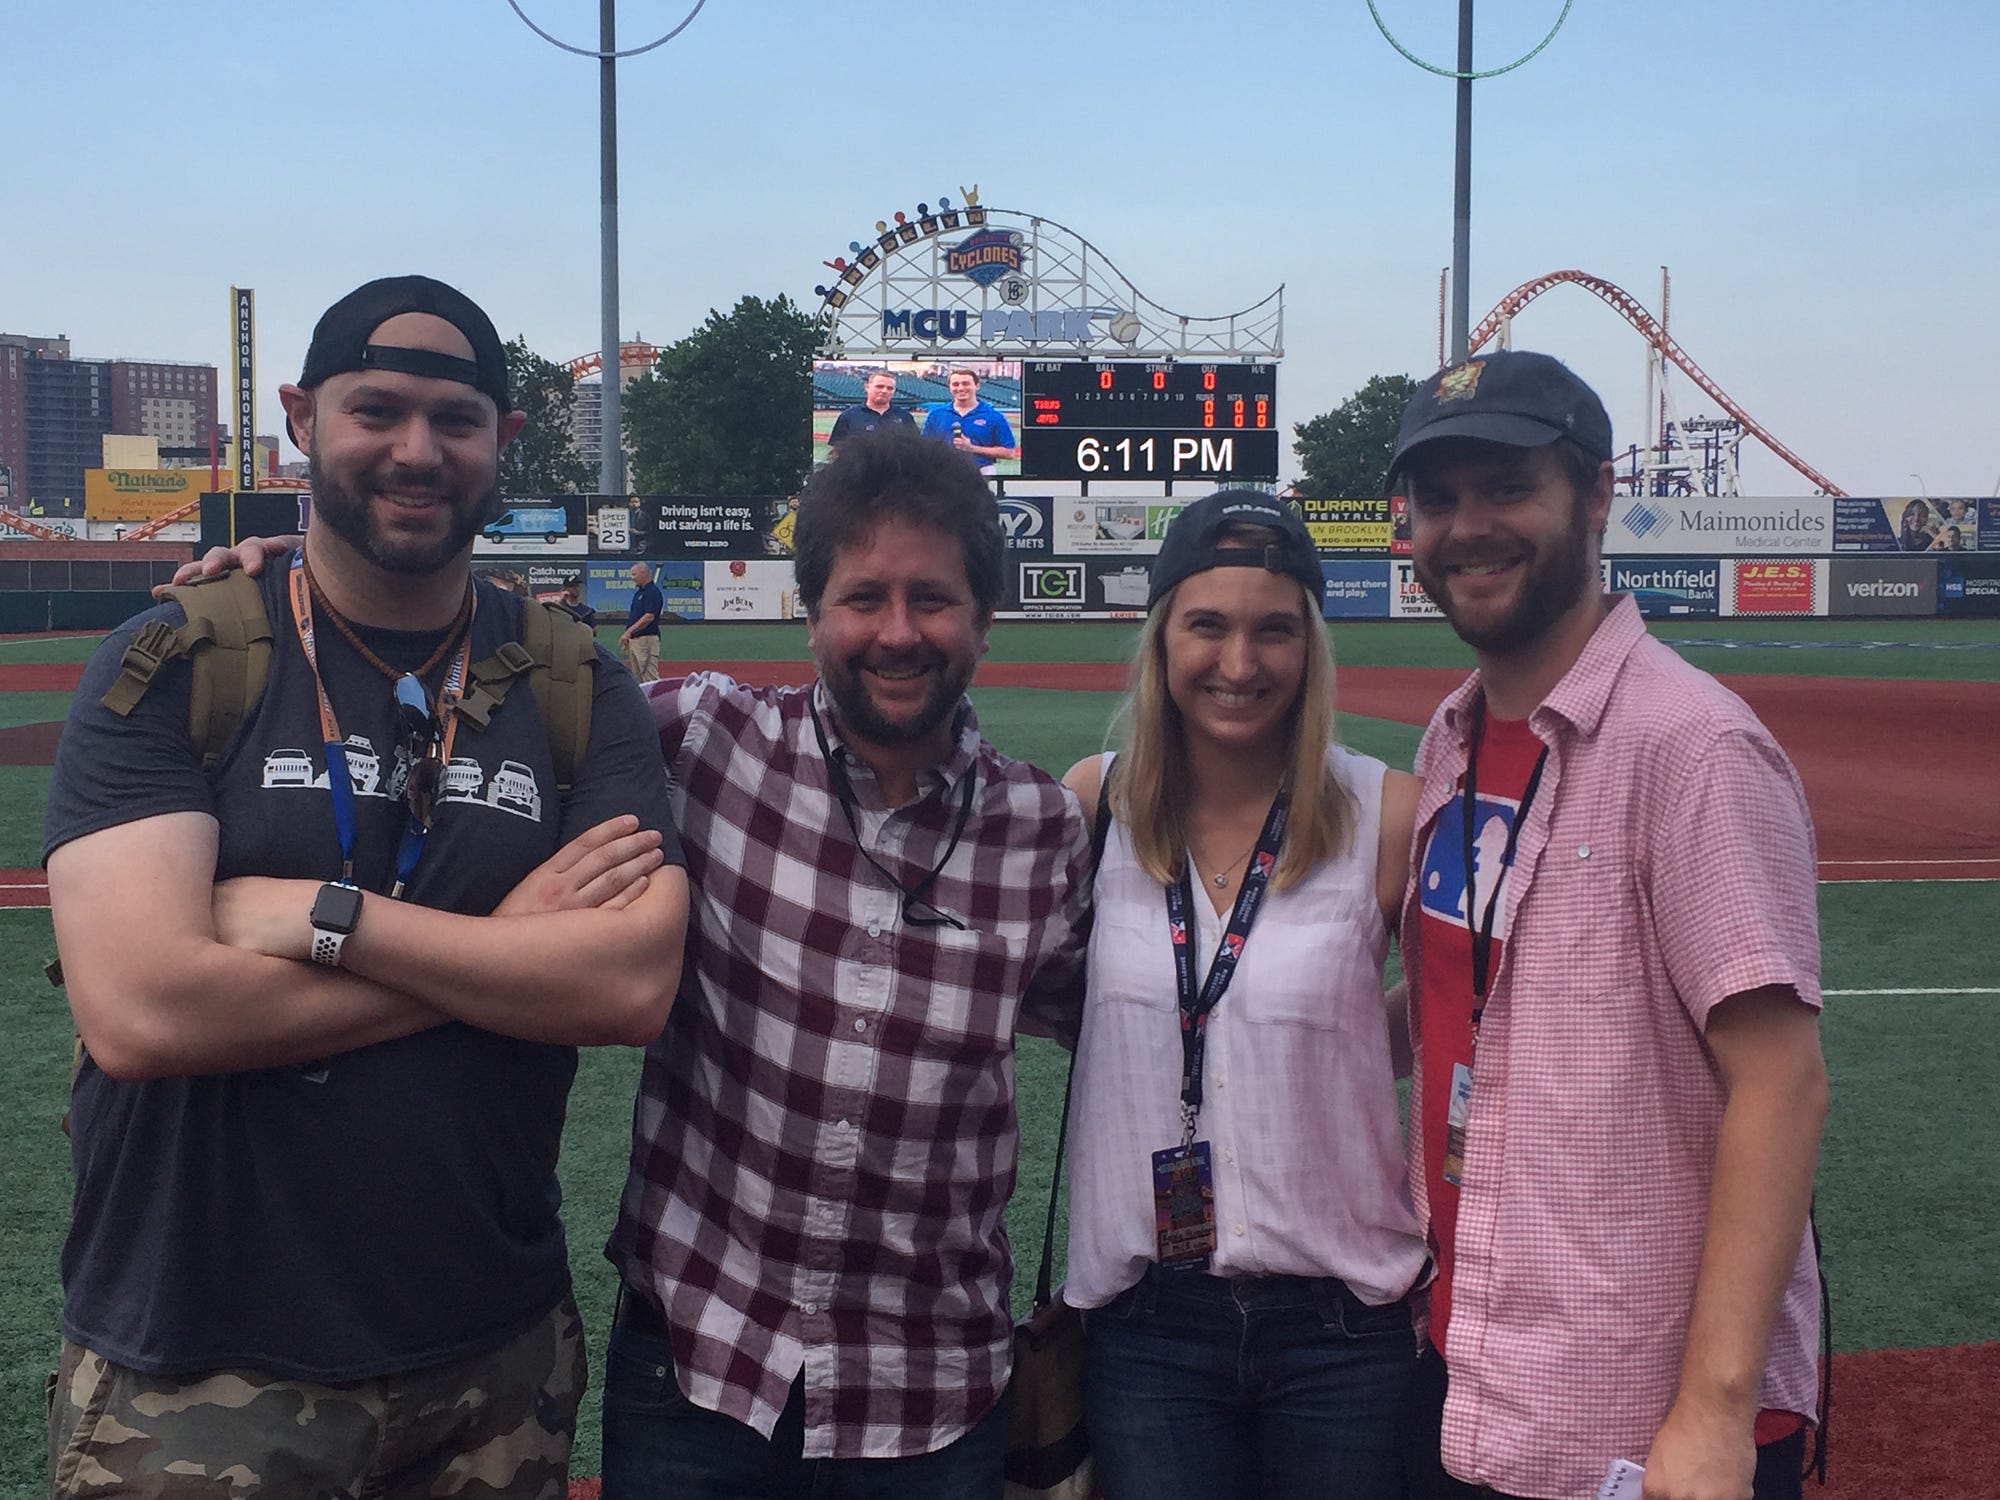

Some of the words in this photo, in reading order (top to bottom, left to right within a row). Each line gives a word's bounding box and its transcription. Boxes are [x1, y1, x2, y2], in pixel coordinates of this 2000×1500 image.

[832, 211, 983, 305] BROOKLYN
[951, 247, 1018, 271] CYCLONES
[241, 296, 250, 368] ANCHOR
[882, 309, 967, 341] MCU
[982, 310, 1095, 342] PARK
[1034, 363, 1044, 372] AT
[1047, 363, 1062, 372] BAT
[1096, 364, 1116, 372] BALL
[1145, 364, 1174, 373] STRIKE
[1201, 365, 1218, 373] OUT
[1100, 372, 1112, 389] 0
[1154, 372, 1165, 389] 0
[1204, 372, 1215, 390] 0
[1204, 400, 1214, 413] 0
[1234, 400, 1244, 413] 0
[1257, 400, 1267, 413] 0
[1204, 414, 1214, 428] 0
[1234, 414, 1244, 428] 0
[1257, 414, 1267, 428] 0
[242, 378, 251, 487] BROKERAGE
[1077, 438, 1154, 472] 6:11
[1173, 438, 1233, 472] PM
[108, 471, 189, 491] Nathan's
[661, 505, 698, 518] Driving
[700, 505, 724, 517] isn't
[725, 507, 752, 518] easy,
[1304, 500, 1388, 512] DURANTE
[1309, 512, 1383, 520] RENTALS
[1679, 509, 1825, 531] Maimonides
[659, 519, 677, 530] but
[679, 520, 713, 532] saving
[714, 522, 722, 530] a
[723, 519, 740, 530] life
[742, 520, 754, 531] is.
[1313, 526, 1325, 534] IN
[1328, 525, 1388, 534] BROOKLYN
[602, 530, 626, 543] 25
[1736, 535, 1780, 547] Medical
[1783, 536, 1821, 547] Center
[1016, 538, 1045, 549] METS
[529, 567, 555, 576] Catch
[557, 568, 581, 576] more
[1743, 566, 1807, 578] J.E.S.
[529, 576, 564, 585] busines
[1027, 569, 1077, 597] TGI
[1326, 580, 1344, 589] Get
[1345, 581, 1360, 589] out
[1362, 579, 1387, 589] there
[1617, 570, 1716, 588] Northfield
[1326, 589, 1344, 597] and
[1345, 589, 1368, 598] play.
[1847, 579, 1919, 597] verizon
[1946, 583, 1962, 591] HSS
[1688, 589, 1715, 599] Bank
[721, 599, 734, 610] JIM
[735, 596, 754, 609] BEAM
